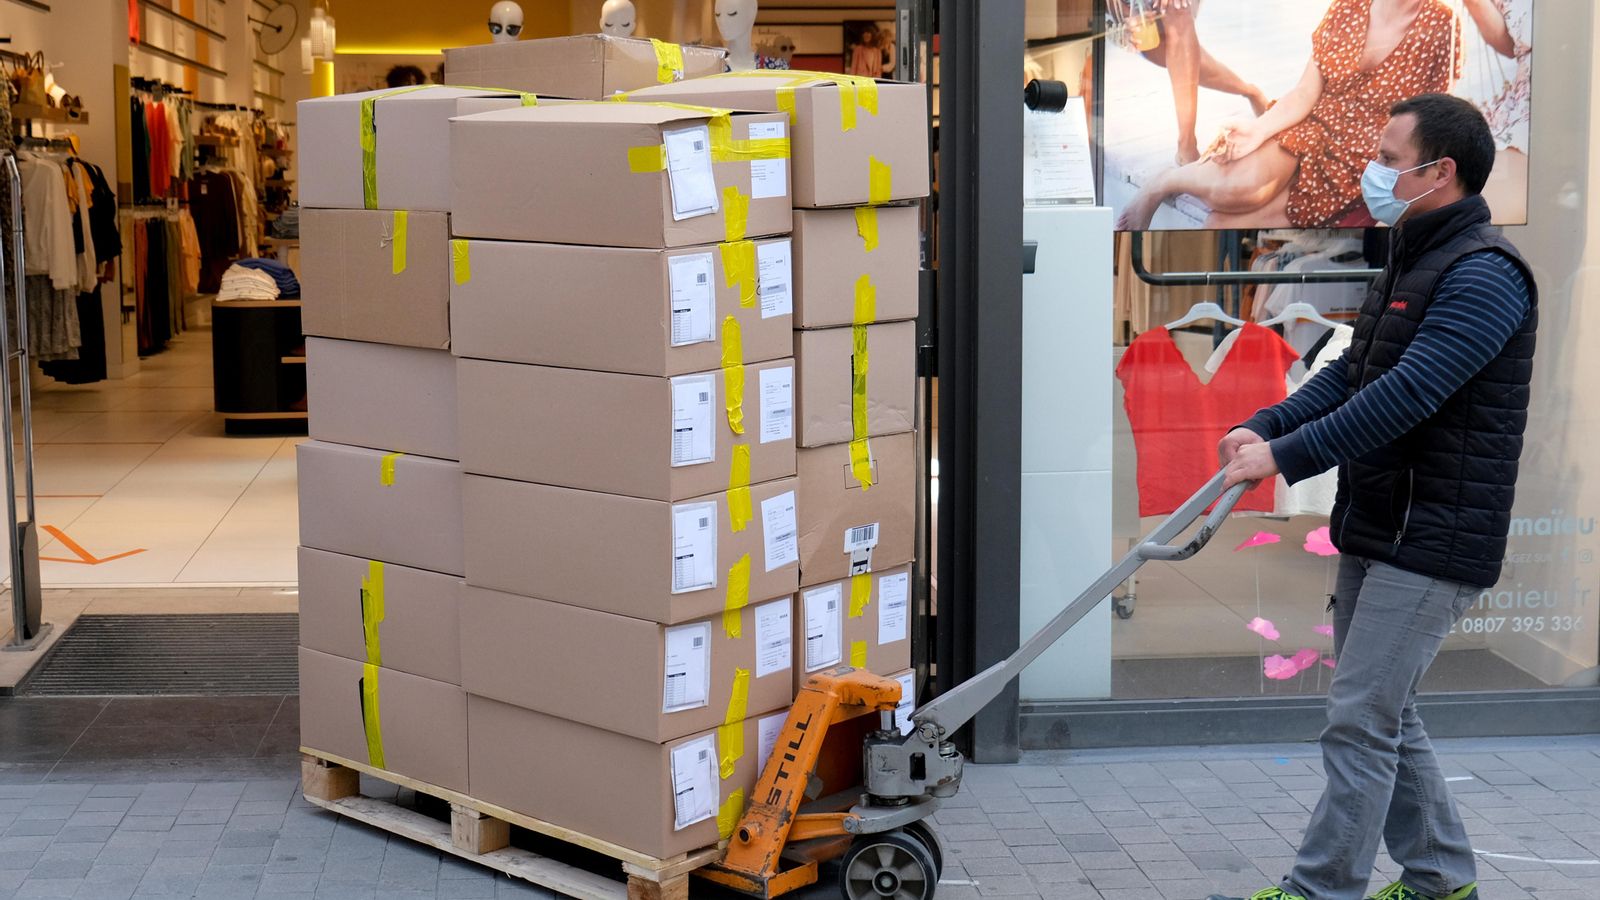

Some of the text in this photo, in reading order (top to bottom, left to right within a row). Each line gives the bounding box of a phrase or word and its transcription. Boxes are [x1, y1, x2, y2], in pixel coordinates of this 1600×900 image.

[1462, 616, 1506, 633] 0807
[1512, 616, 1545, 632] 395
[1551, 615, 1585, 631] 336
[766, 713, 813, 806] STILL
